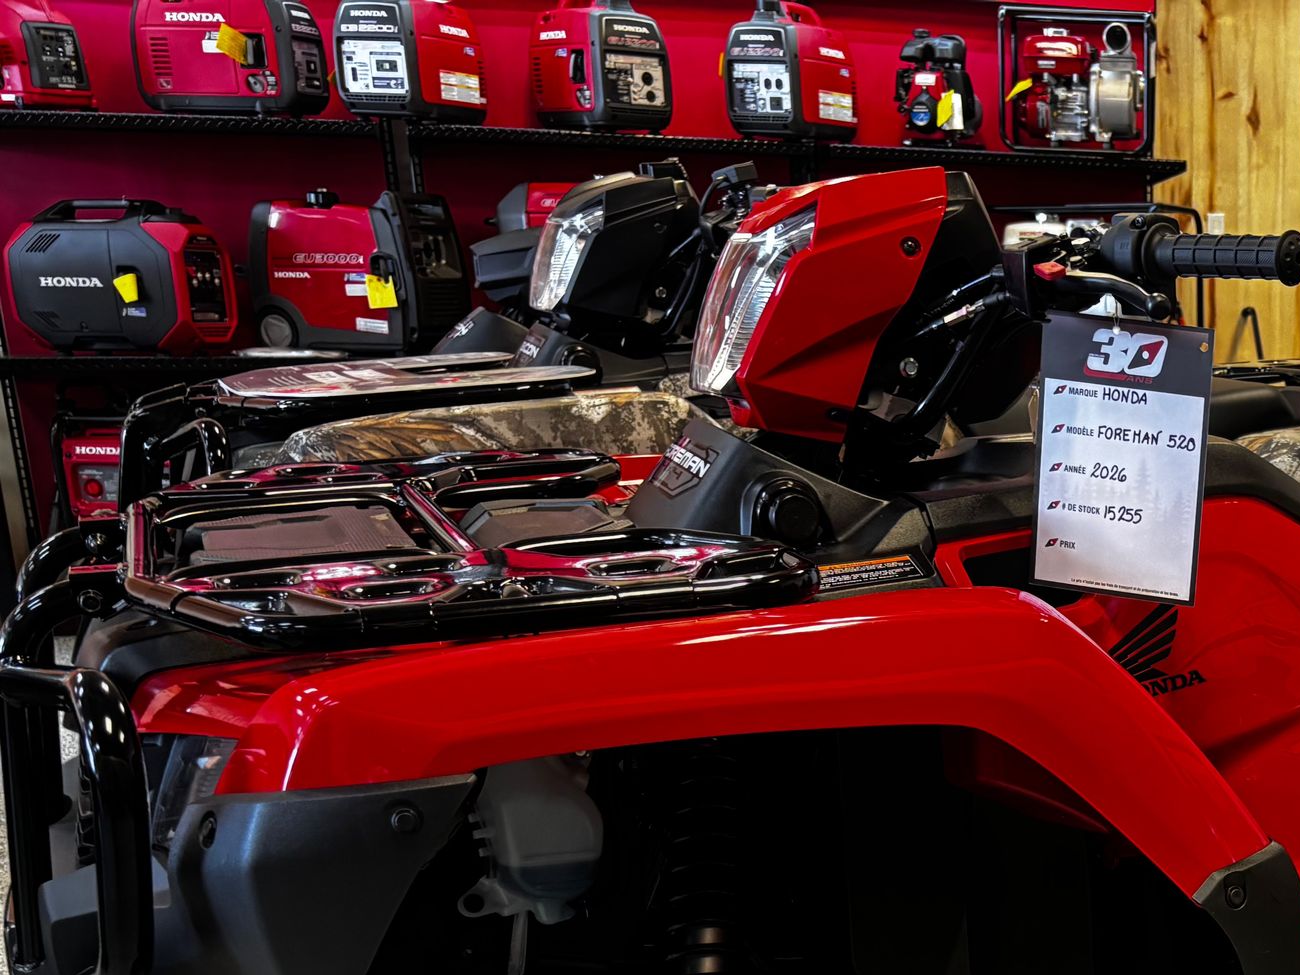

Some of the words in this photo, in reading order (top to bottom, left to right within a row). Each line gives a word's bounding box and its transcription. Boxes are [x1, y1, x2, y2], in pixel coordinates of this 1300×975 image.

[164, 12, 225, 22] HONDA
[613, 24, 650, 34] HONDA
[274, 271, 311, 279] HONDA
[39, 276, 104, 288] HONDA
[1126, 376, 1153, 385] ANS
[1068, 386, 1098, 398] MARQUE
[1102, 387, 1148, 405] HONDA
[1066, 425, 1094, 437] MODÈLE
[1097, 425, 1163, 446] FOREMAN
[1166, 434, 1196, 452] 520
[1063, 463, 1086, 475] ANNÉE
[1090, 462, 1128, 482] 2026
[1067, 503, 1077, 512] DE
[1078, 504, 1101, 516] STOCK
[1059, 540, 1076, 550] PRIX
